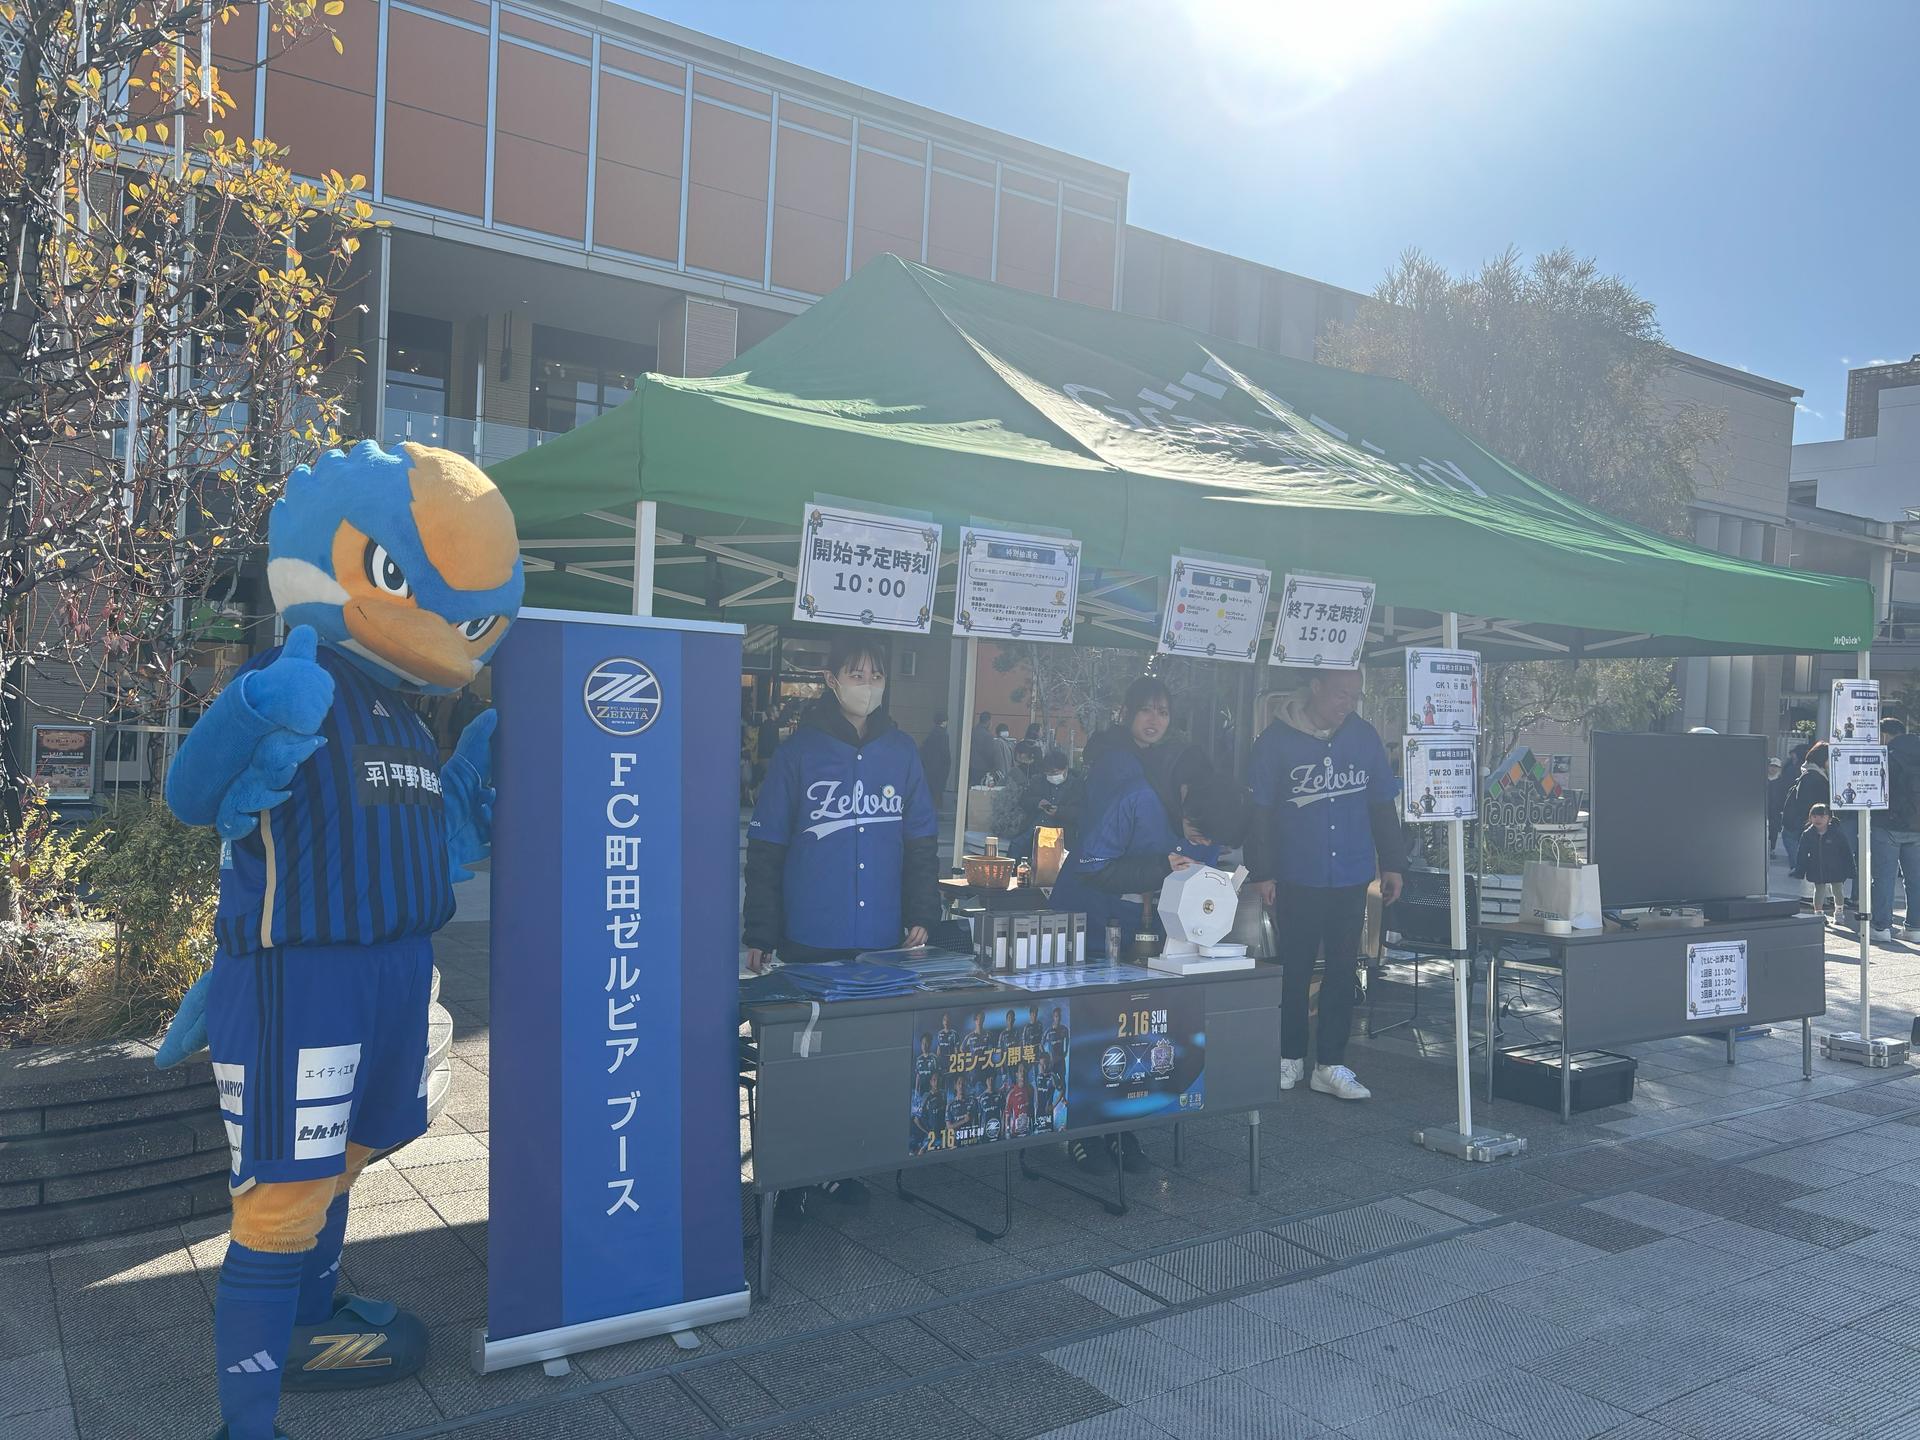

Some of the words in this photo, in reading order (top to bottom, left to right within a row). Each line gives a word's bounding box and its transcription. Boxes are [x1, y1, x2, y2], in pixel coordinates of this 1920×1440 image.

[812, 537, 931, 575] 開始予定時刻
[833, 572, 906, 598] 10:00
[1286, 601, 1365, 625] 終了予定時刻
[1298, 626, 1347, 644] 15:00
[1435, 681, 1445, 690] GK
[596, 706, 649, 720] ZELVIA
[1290, 763, 1370, 794] Zelvia
[1428, 769, 1441, 777] FW
[1442, 769, 1452, 777] 20
[806, 779, 905, 820] Zelvia
[1504, 826, 1542, 852] Park
[605, 752, 642, 1075] FC町田ゼルビア
[1118, 1010, 1149, 1038] 2.16
[1151, 1009, 1168, 1024] SUN
[949, 1044, 1037, 1073] 25シーズン開幕
[927, 1128, 955, 1151] 2.16
[956, 1130, 968, 1140] SUN
[606, 1090, 642, 1217] ブース
